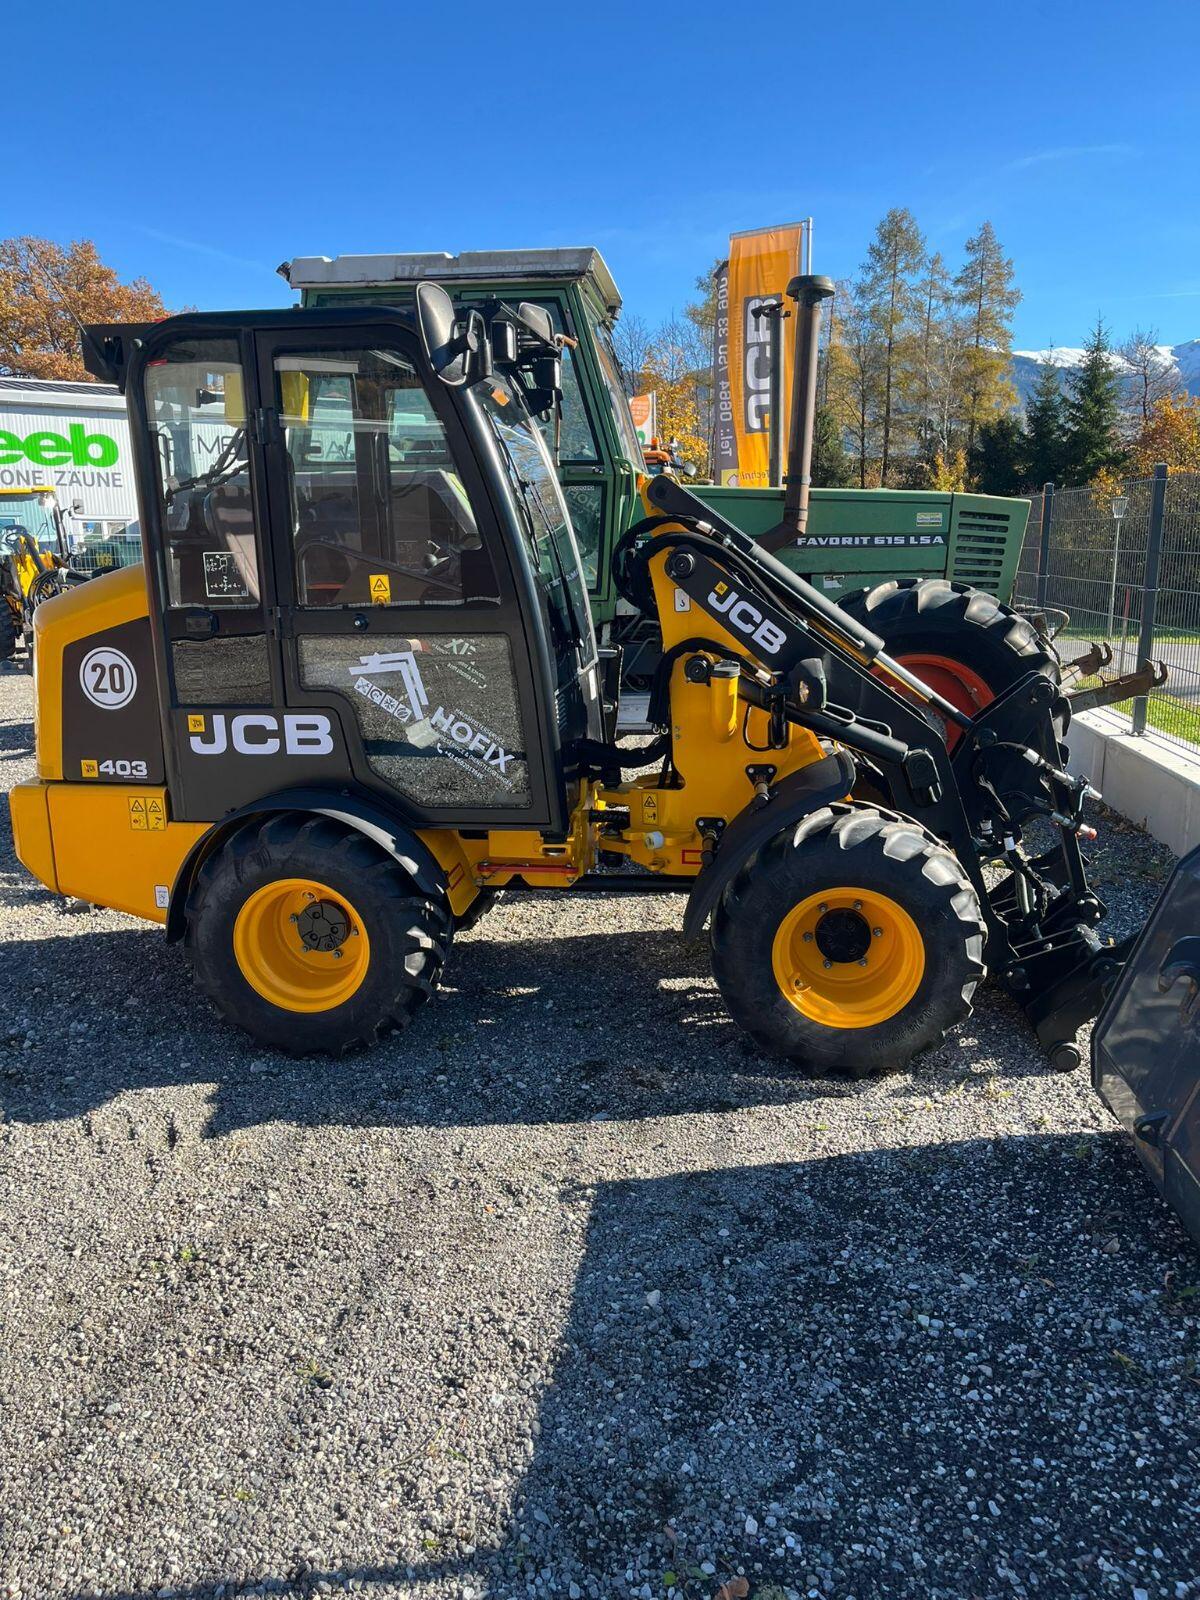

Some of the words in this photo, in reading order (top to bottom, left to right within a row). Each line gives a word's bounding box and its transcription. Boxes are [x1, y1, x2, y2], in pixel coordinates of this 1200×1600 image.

[54, 470, 123, 488] ZÄUNE
[797, 536, 871, 546] FAVORIT
[874, 536, 905, 545] 615
[909, 535, 944, 544] LSA
[707, 591, 787, 655] JCB
[91, 663, 126, 694] 20
[188, 714, 334, 755] JCB
[430, 705, 515, 774] HOFIX
[99, 759, 148, 778] 403
